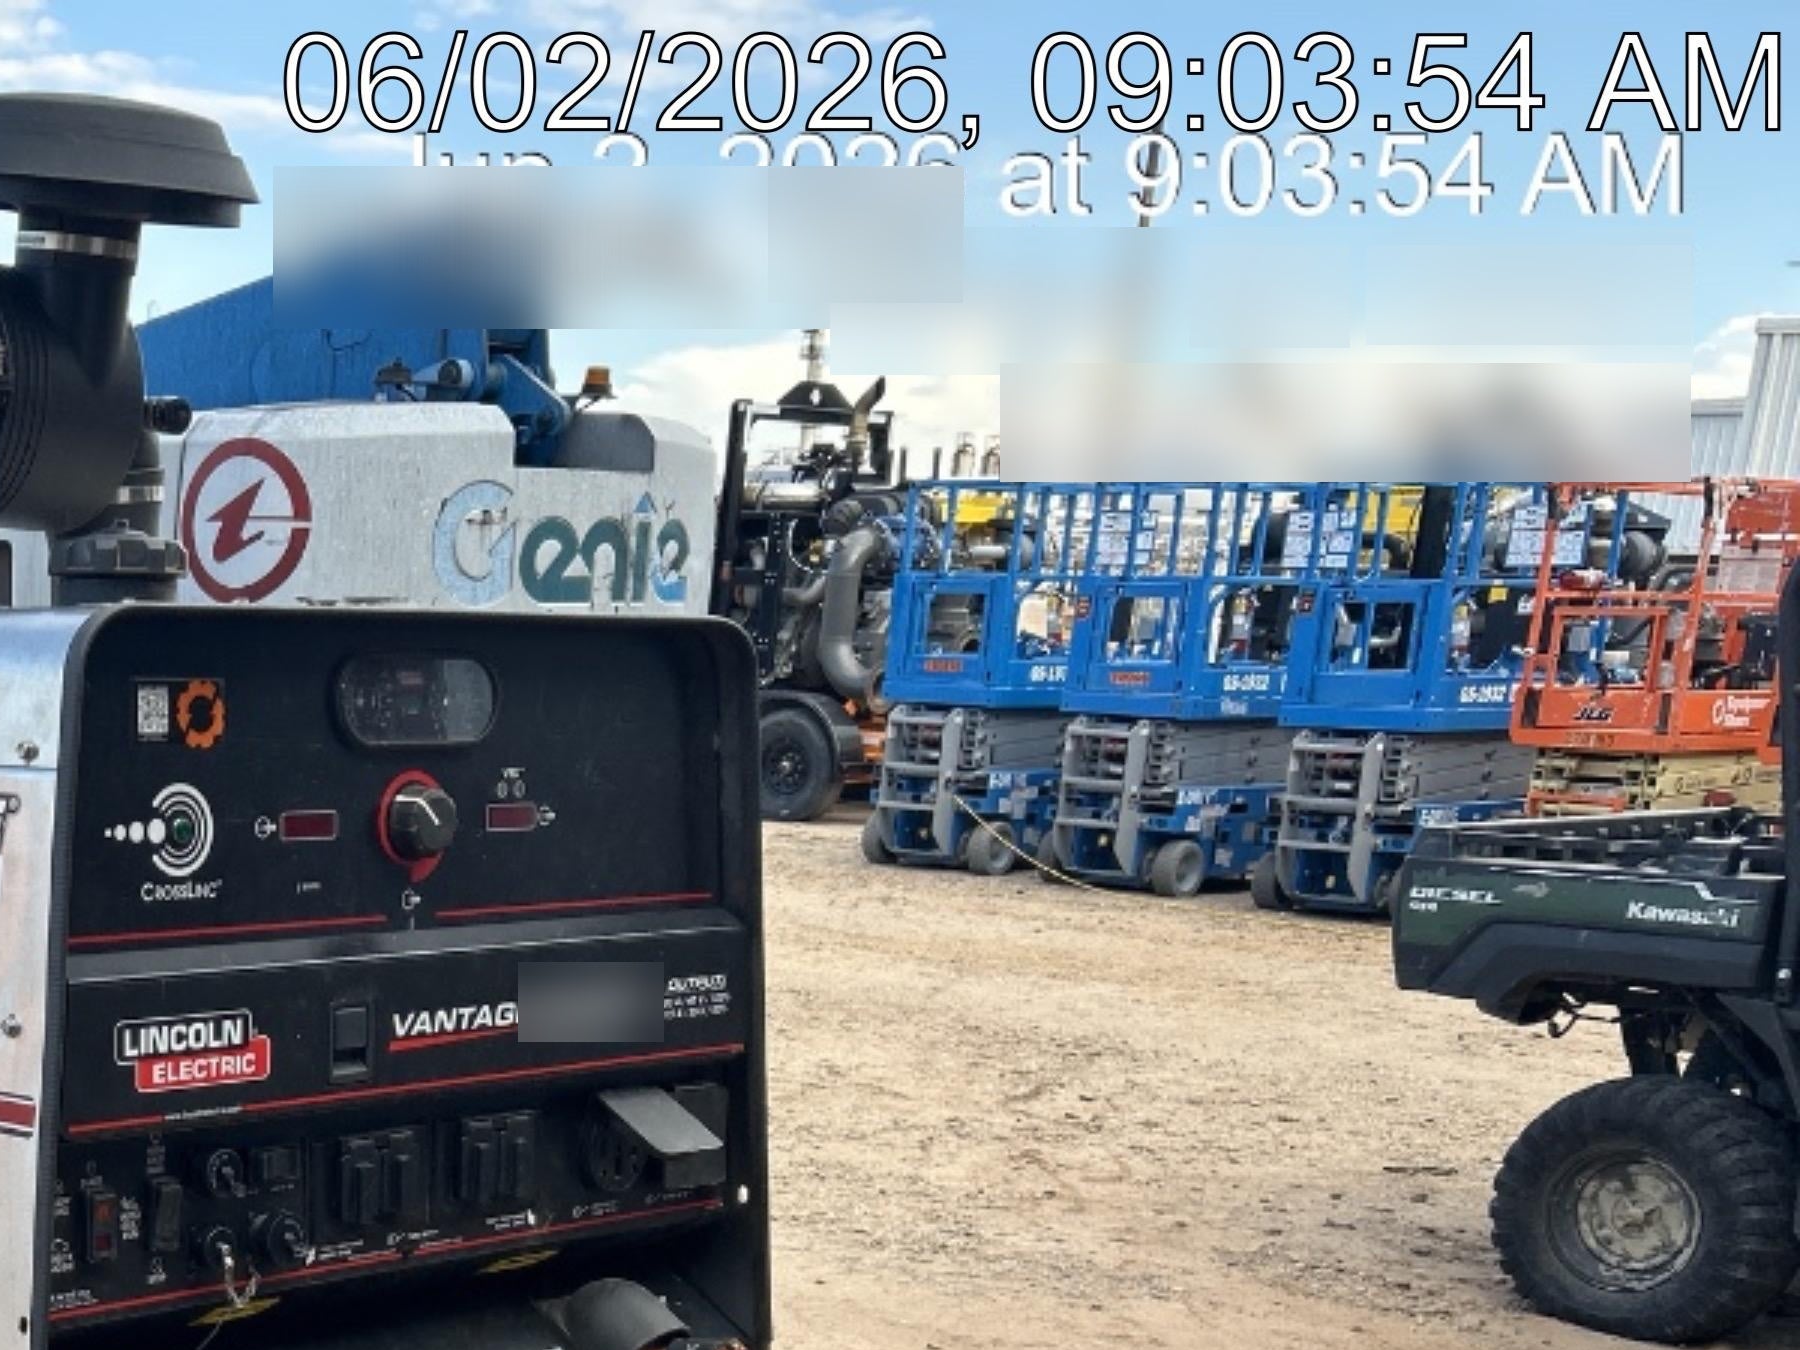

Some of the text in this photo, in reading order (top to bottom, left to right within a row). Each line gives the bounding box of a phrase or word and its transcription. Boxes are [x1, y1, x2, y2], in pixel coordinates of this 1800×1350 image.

[432, 479, 690, 605] Genie
[123, 1017, 244, 1058] LINCOLN
[391, 1001, 519, 1038] VANTAG
[151, 1052, 257, 1085] ELECTRIC
